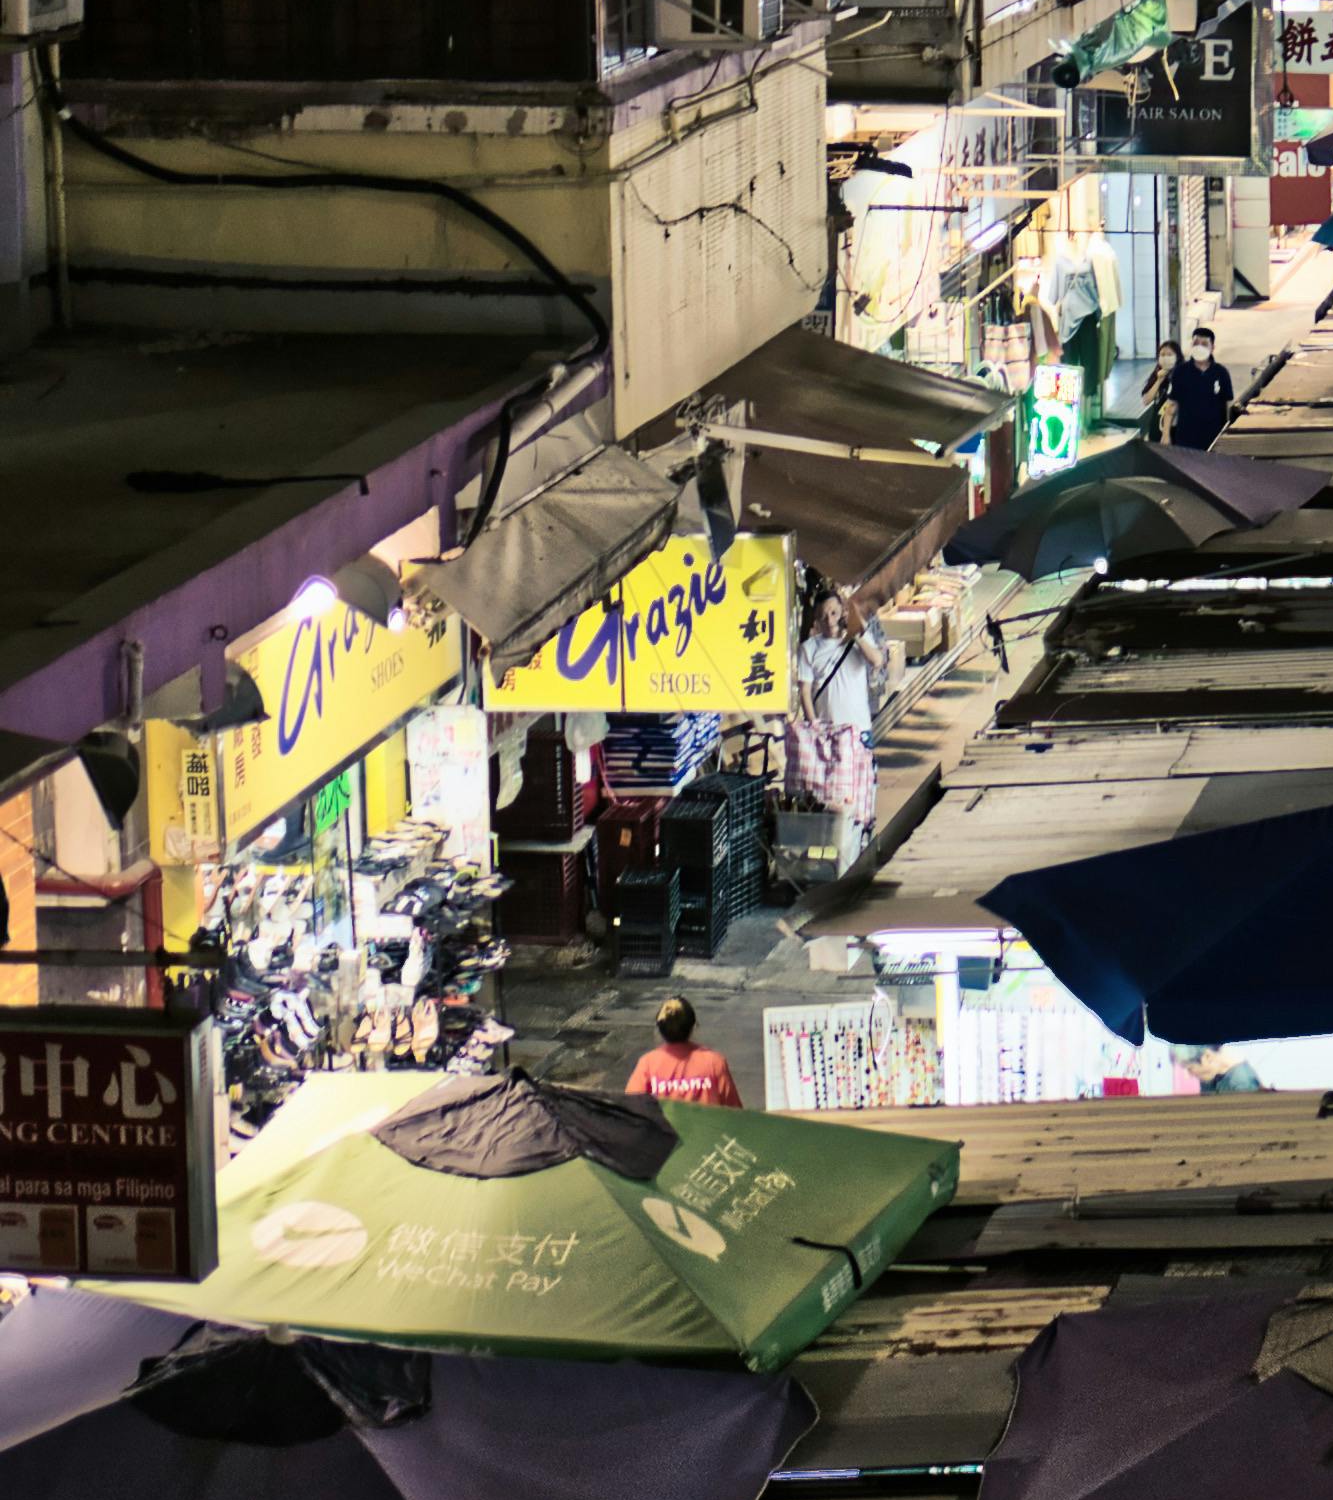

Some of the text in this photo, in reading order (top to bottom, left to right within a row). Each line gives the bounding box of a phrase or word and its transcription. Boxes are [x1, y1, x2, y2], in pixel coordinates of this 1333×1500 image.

[1127, 108, 1222, 121] HAIR SALON
[556, 553, 726, 685] Grazie
[739, 609, 776, 697] 利嘉
[371, 653, 405, 692] SHOES
[650, 673, 712, 696] SHOES
[47, 1122, 177, 1147] CENTRE
[15, 1179, 49, 1198] para
[55, 1180, 73, 1196] sa
[77, 1181, 111, 1201] mga
[116, 1177, 175, 1202] Filipino
[377, 1257, 562, 1297] WeChat Pay
